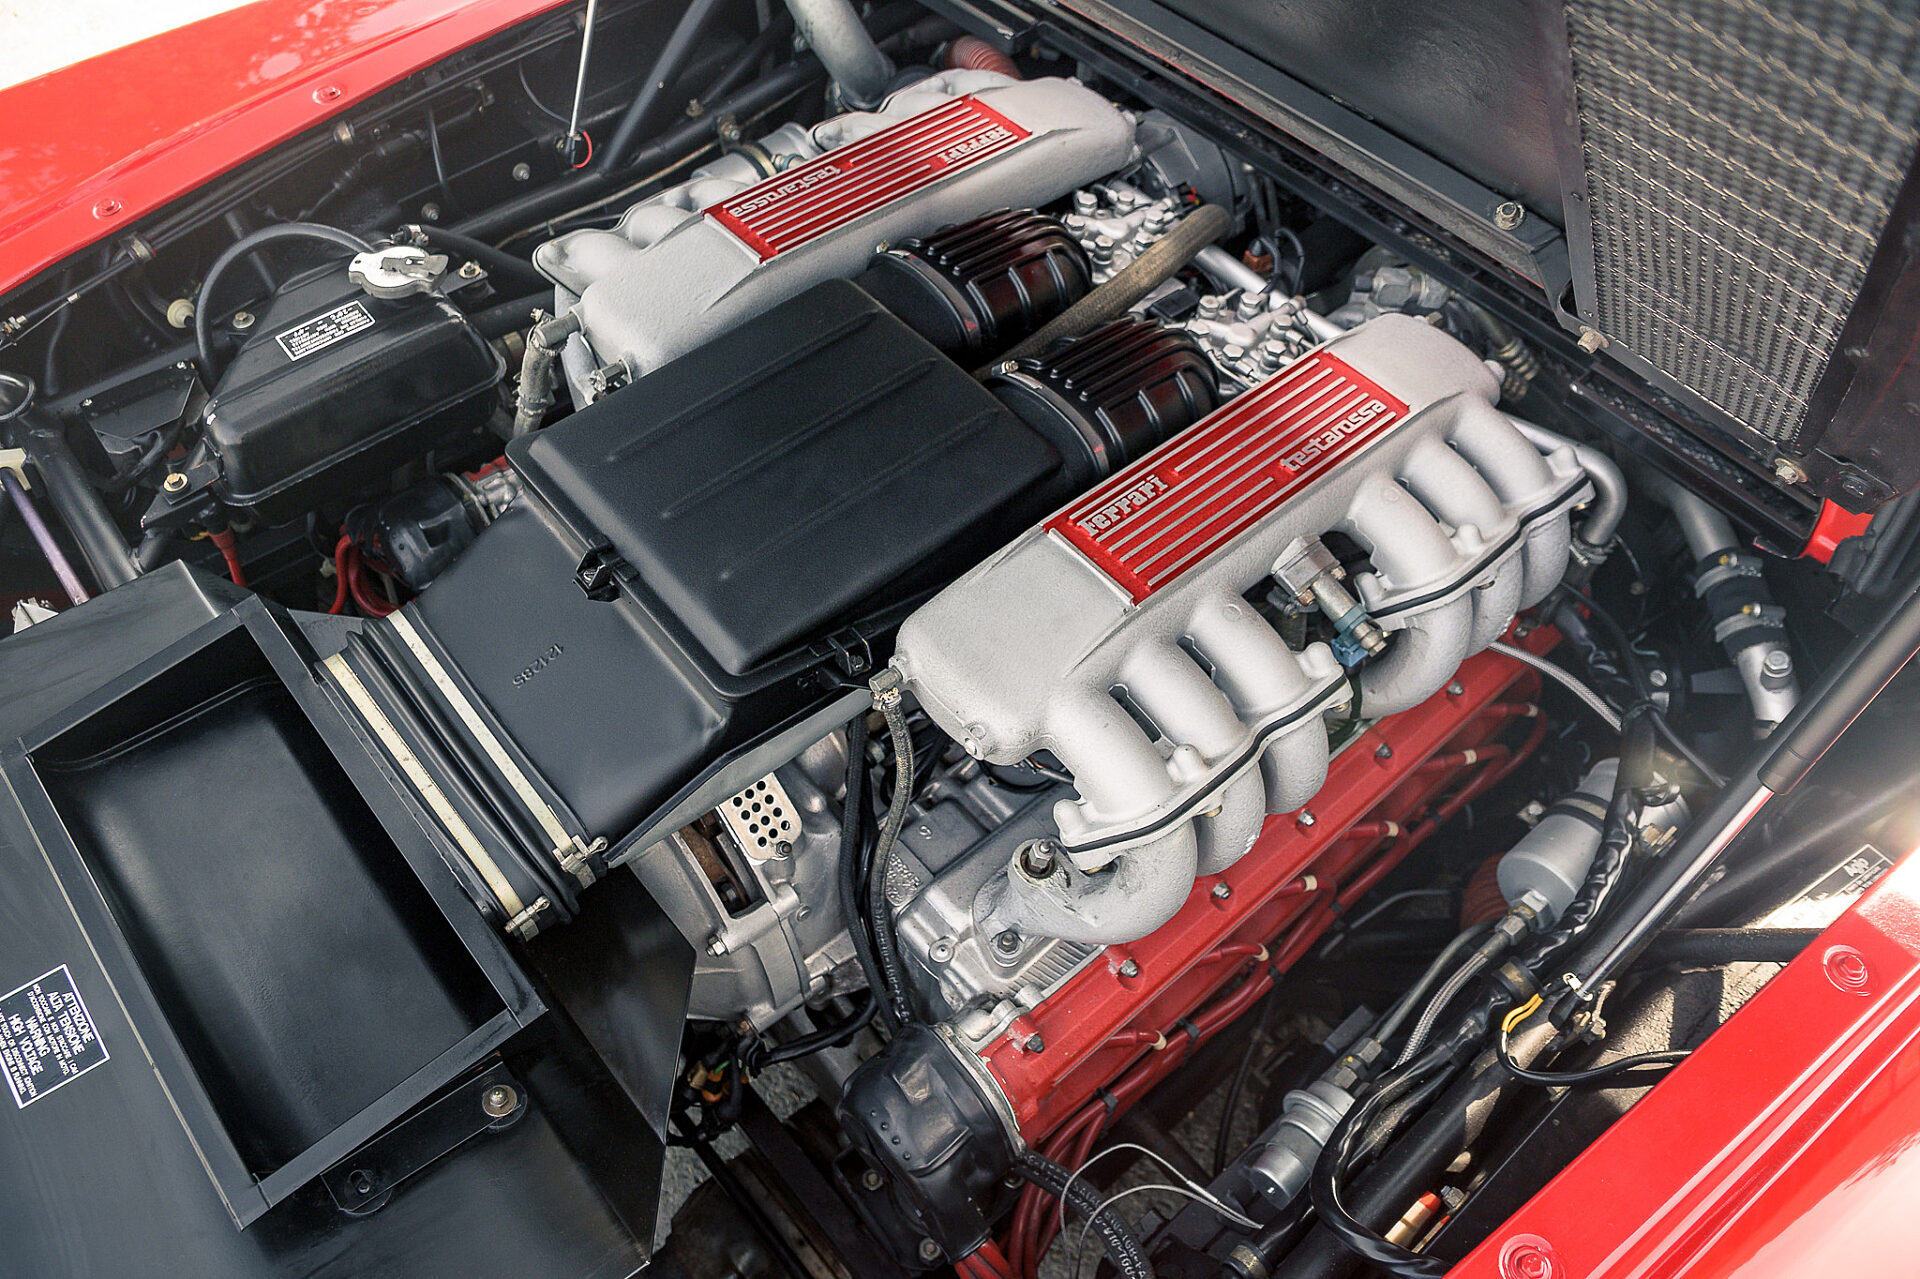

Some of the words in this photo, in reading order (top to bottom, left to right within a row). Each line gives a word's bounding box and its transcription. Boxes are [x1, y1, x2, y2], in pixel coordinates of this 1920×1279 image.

[937, 127, 1013, 165] Ferrari
[727, 164, 842, 218] testarossa
[1279, 397, 1389, 473] testarossa
[1075, 474, 1171, 537] Ferrari
[8, 1014, 26, 1036] HIGH
[19, 1036, 43, 1075] VOLTAGE
[22, 1016, 50, 1057] WARNING
[47, 992, 64, 1012] ALTA
[58, 1011, 85, 1055] TENSIONE
[62, 992, 94, 1043] ATTENZIONE
